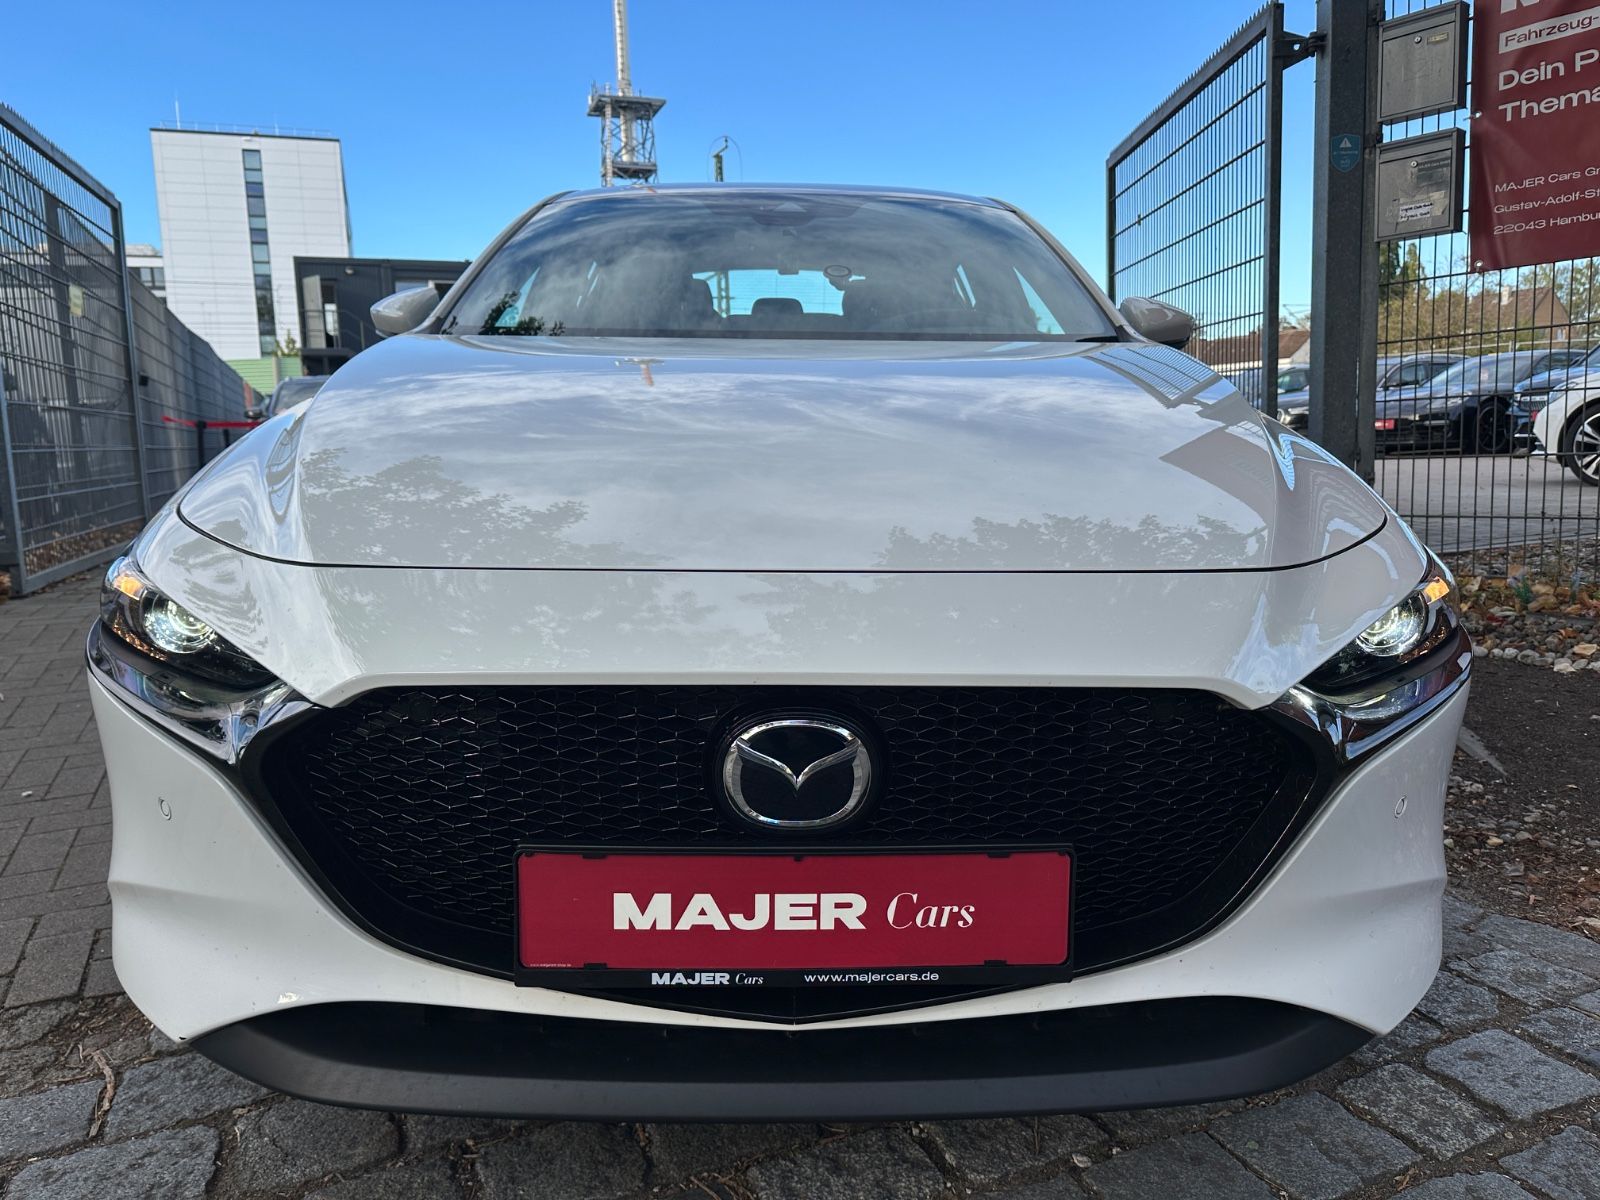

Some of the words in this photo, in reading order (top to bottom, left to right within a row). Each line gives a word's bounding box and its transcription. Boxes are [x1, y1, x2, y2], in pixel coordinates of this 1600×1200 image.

[1505, 16, 1599, 47] Fahrzeug-
[1498, 61, 1565, 91] Dein
[1494, 176, 1545, 193] MAJER
[1548, 171, 1581, 183] Cars
[1493, 219, 1546, 235] 22043
[613, 892, 868, 930] MAJER
[886, 891, 976, 930] Cars
[651, 972, 731, 985] MAJER
[735, 972, 765, 985] Cars
[804, 971, 940, 984] www.majercars.de
